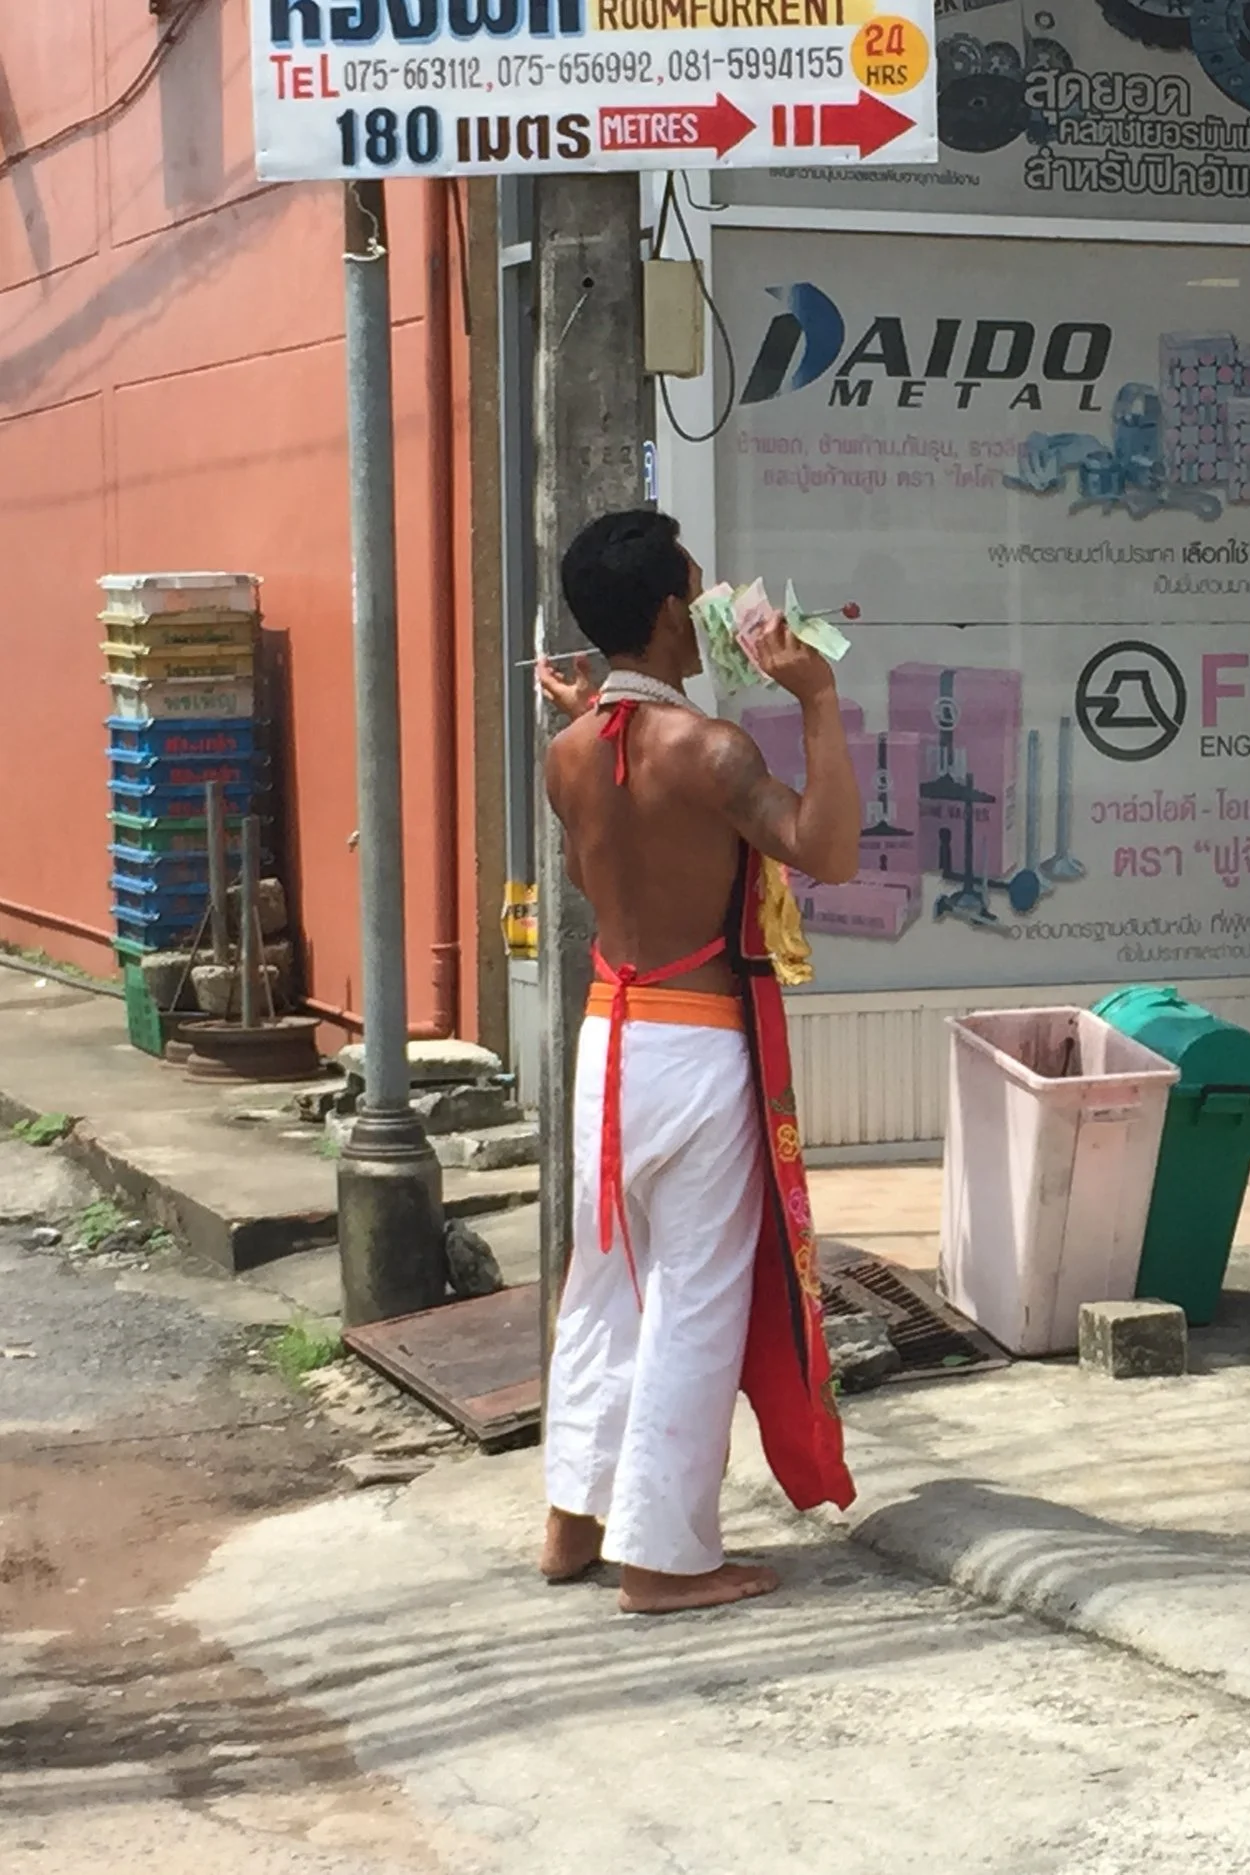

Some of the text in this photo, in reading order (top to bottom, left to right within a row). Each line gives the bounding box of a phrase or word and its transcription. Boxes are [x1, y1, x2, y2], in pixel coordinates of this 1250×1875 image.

[865, 23, 905, 57] 24
[269, 53, 340, 100] TEL
[865, 65, 908, 87] HRS
[1023, 67, 1191, 123] สุดยอด
[336, 105, 699, 167] 180 เมตร METRES
[739, 281, 1113, 405] DAIDO
[828, 378, 1103, 411] METAL
[1181, 538, 1250, 565] เลือกใช้
[1113, 844, 1184, 878] ตรา
